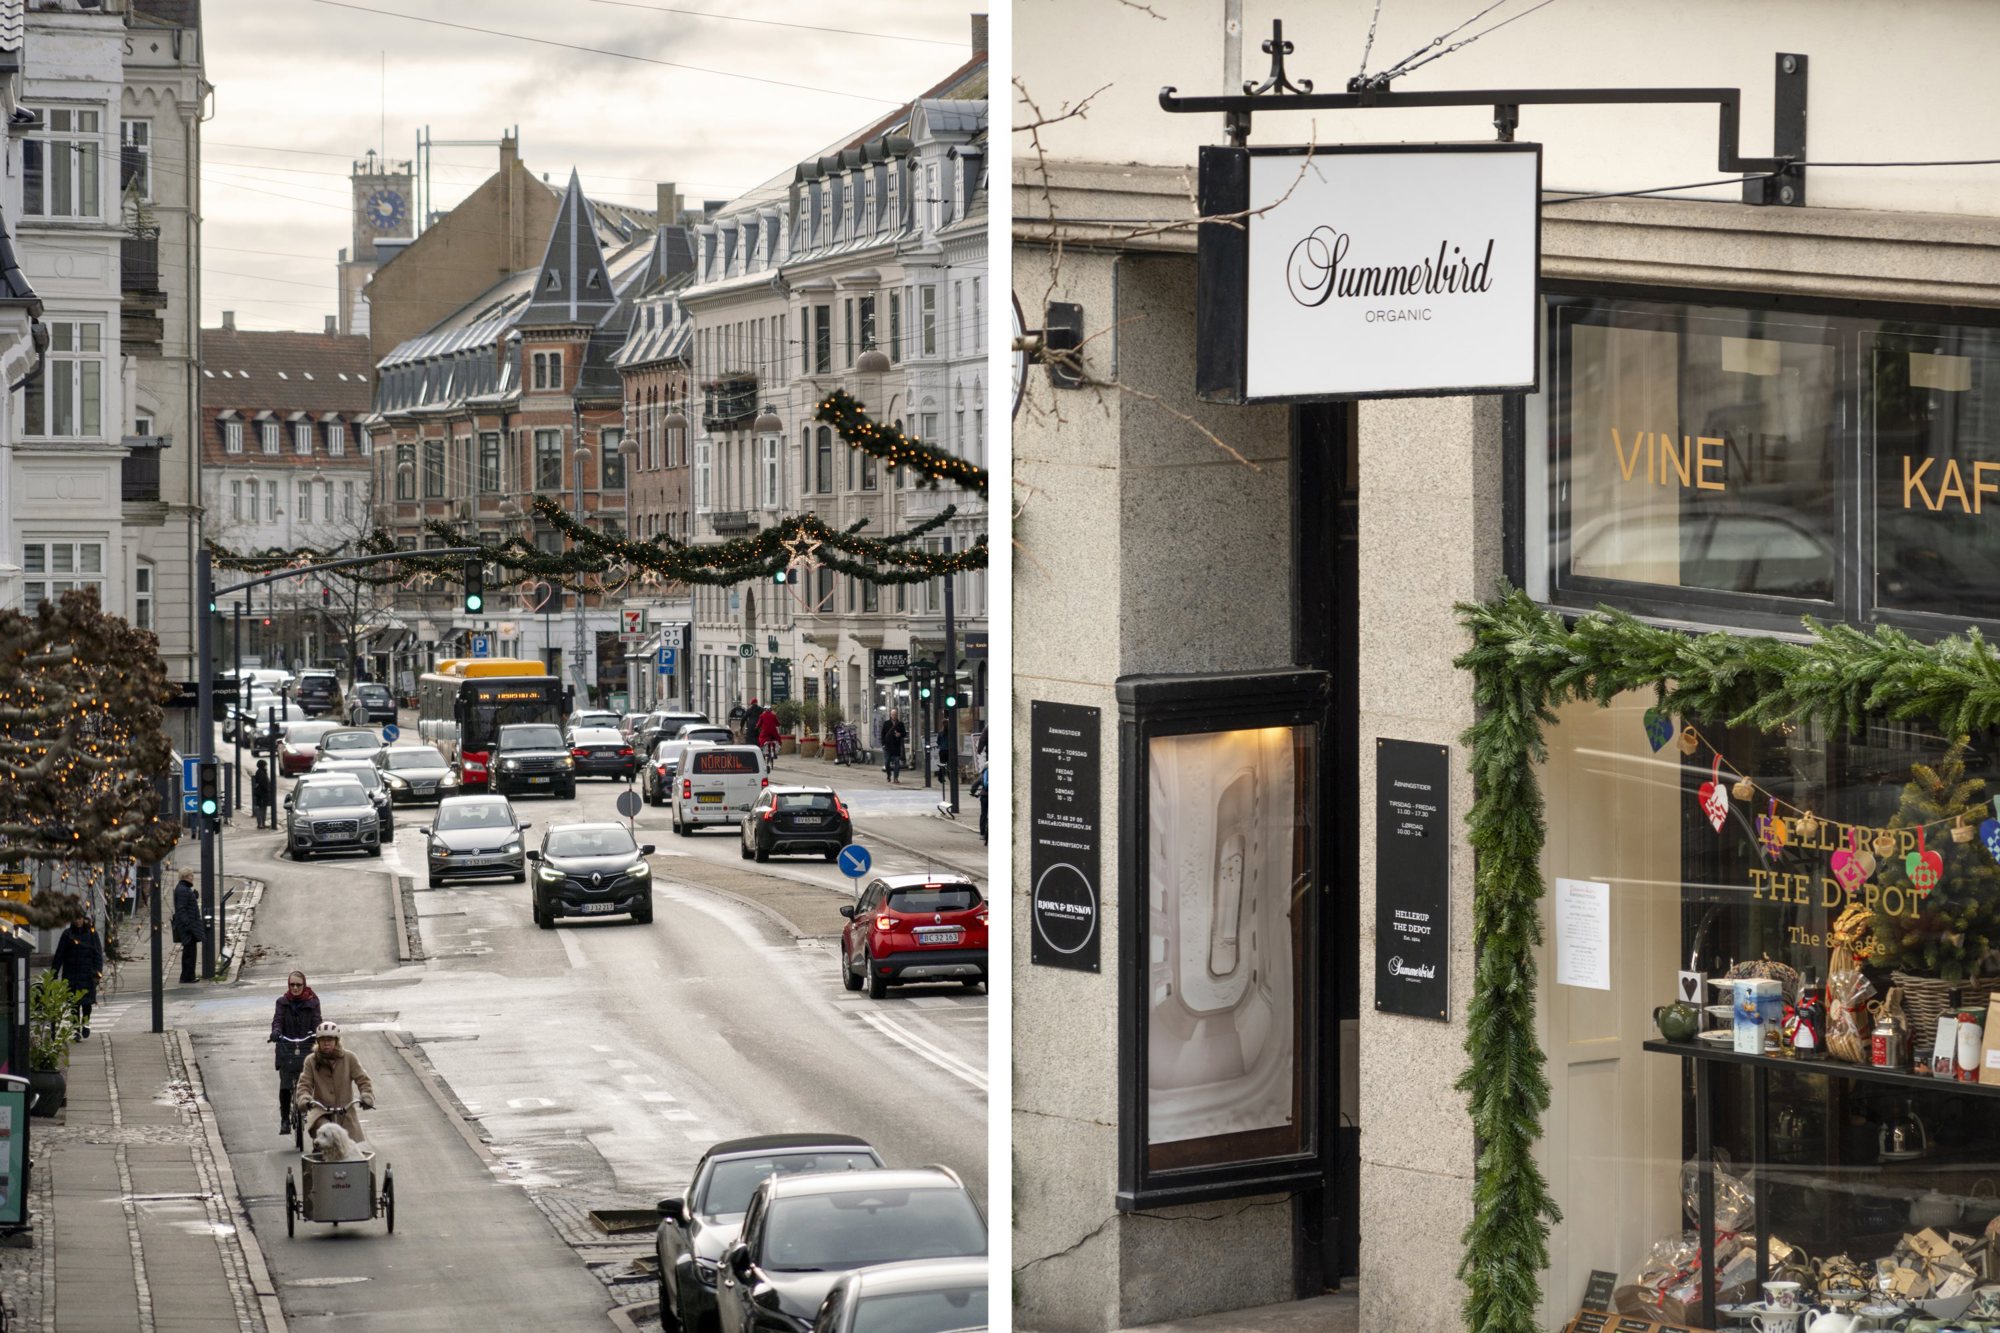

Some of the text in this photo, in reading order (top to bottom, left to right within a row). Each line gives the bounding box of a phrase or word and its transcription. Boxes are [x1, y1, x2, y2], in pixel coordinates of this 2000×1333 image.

[1286, 225, 1494, 308] Summerbird
[1365, 308, 1432, 322] ORGANIC
[1611, 428, 1726, 491] VINE
[662, 650, 672, 663] P
[1049, 727, 1080, 736] ÅBNINGSTIDER
[1394, 780, 1431, 790] ÅBNINGSTIDER
[1415, 804, 1436, 812] FREDAG
[1758, 814, 1915, 860] HELLERP
[1749, 868, 1810, 904] THE
[1066, 904, 1092, 915] BYSKOV
[1395, 910, 1430, 921] HELLERUP
[1393, 922, 1431, 934] THE DEPOT
[1788, 926, 1820, 947] The
[1388, 956, 1435, 978] Summerbird
